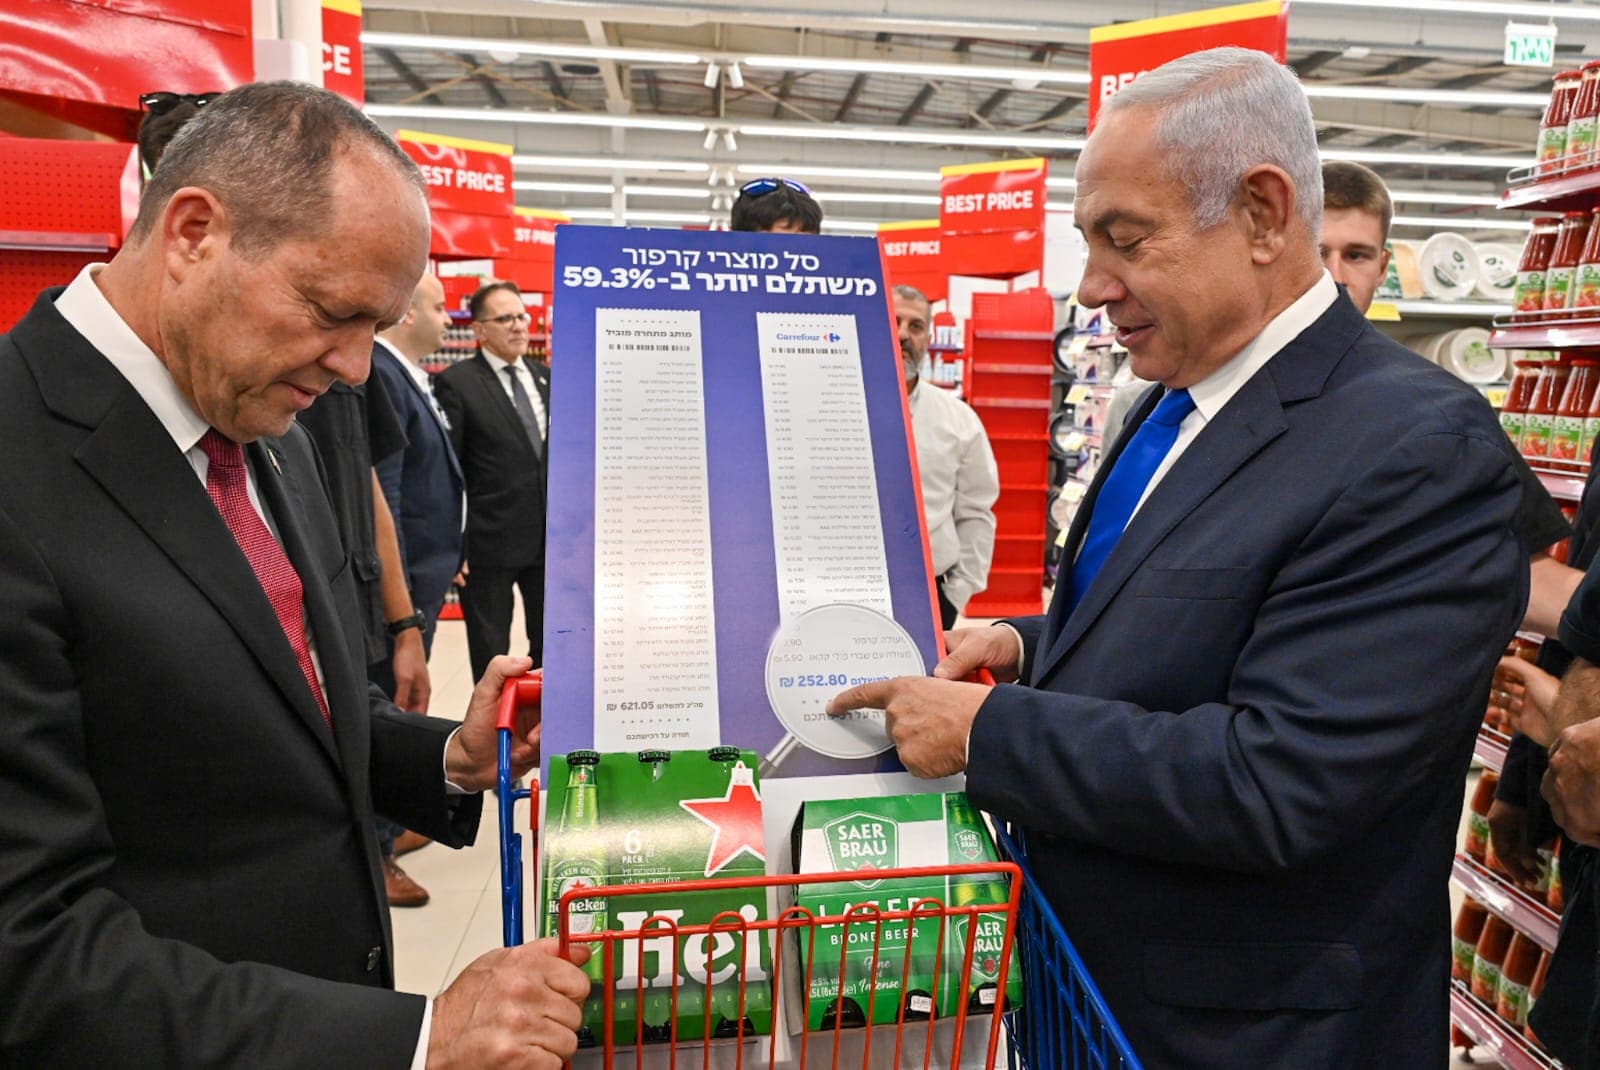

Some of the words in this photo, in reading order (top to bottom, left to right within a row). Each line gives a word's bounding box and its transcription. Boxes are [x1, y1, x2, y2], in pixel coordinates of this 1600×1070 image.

[420, 166, 454, 187] EST
[457, 172, 505, 193] PRICE
[945, 195, 985, 213] BEST
[987, 190, 1033, 210] PRICE
[622, 247, 701, 271] קרפור
[707, 251, 779, 270] מוצרי
[783, 251, 820, 271] סל
[695, 272, 759, 292] יותר
[765, 272, 877, 296] משתלם
[606, 328, 632, 337] מוביל
[634, 330, 667, 338] מתחרה
[669, 330, 693, 339] מותג
[776, 332, 820, 342] Carrefour
[797, 674, 848, 687] 252.80
[620, 701, 654, 711] 621.05
[838, 823, 886, 840] SAER
[624, 829, 641, 854] 6
[840, 840, 887, 857] BRAU
[622, 855, 644, 864] PACK
[885, 928, 920, 940] BEER
[975, 922, 1003, 937] AER
[616, 904, 767, 990] Hei
